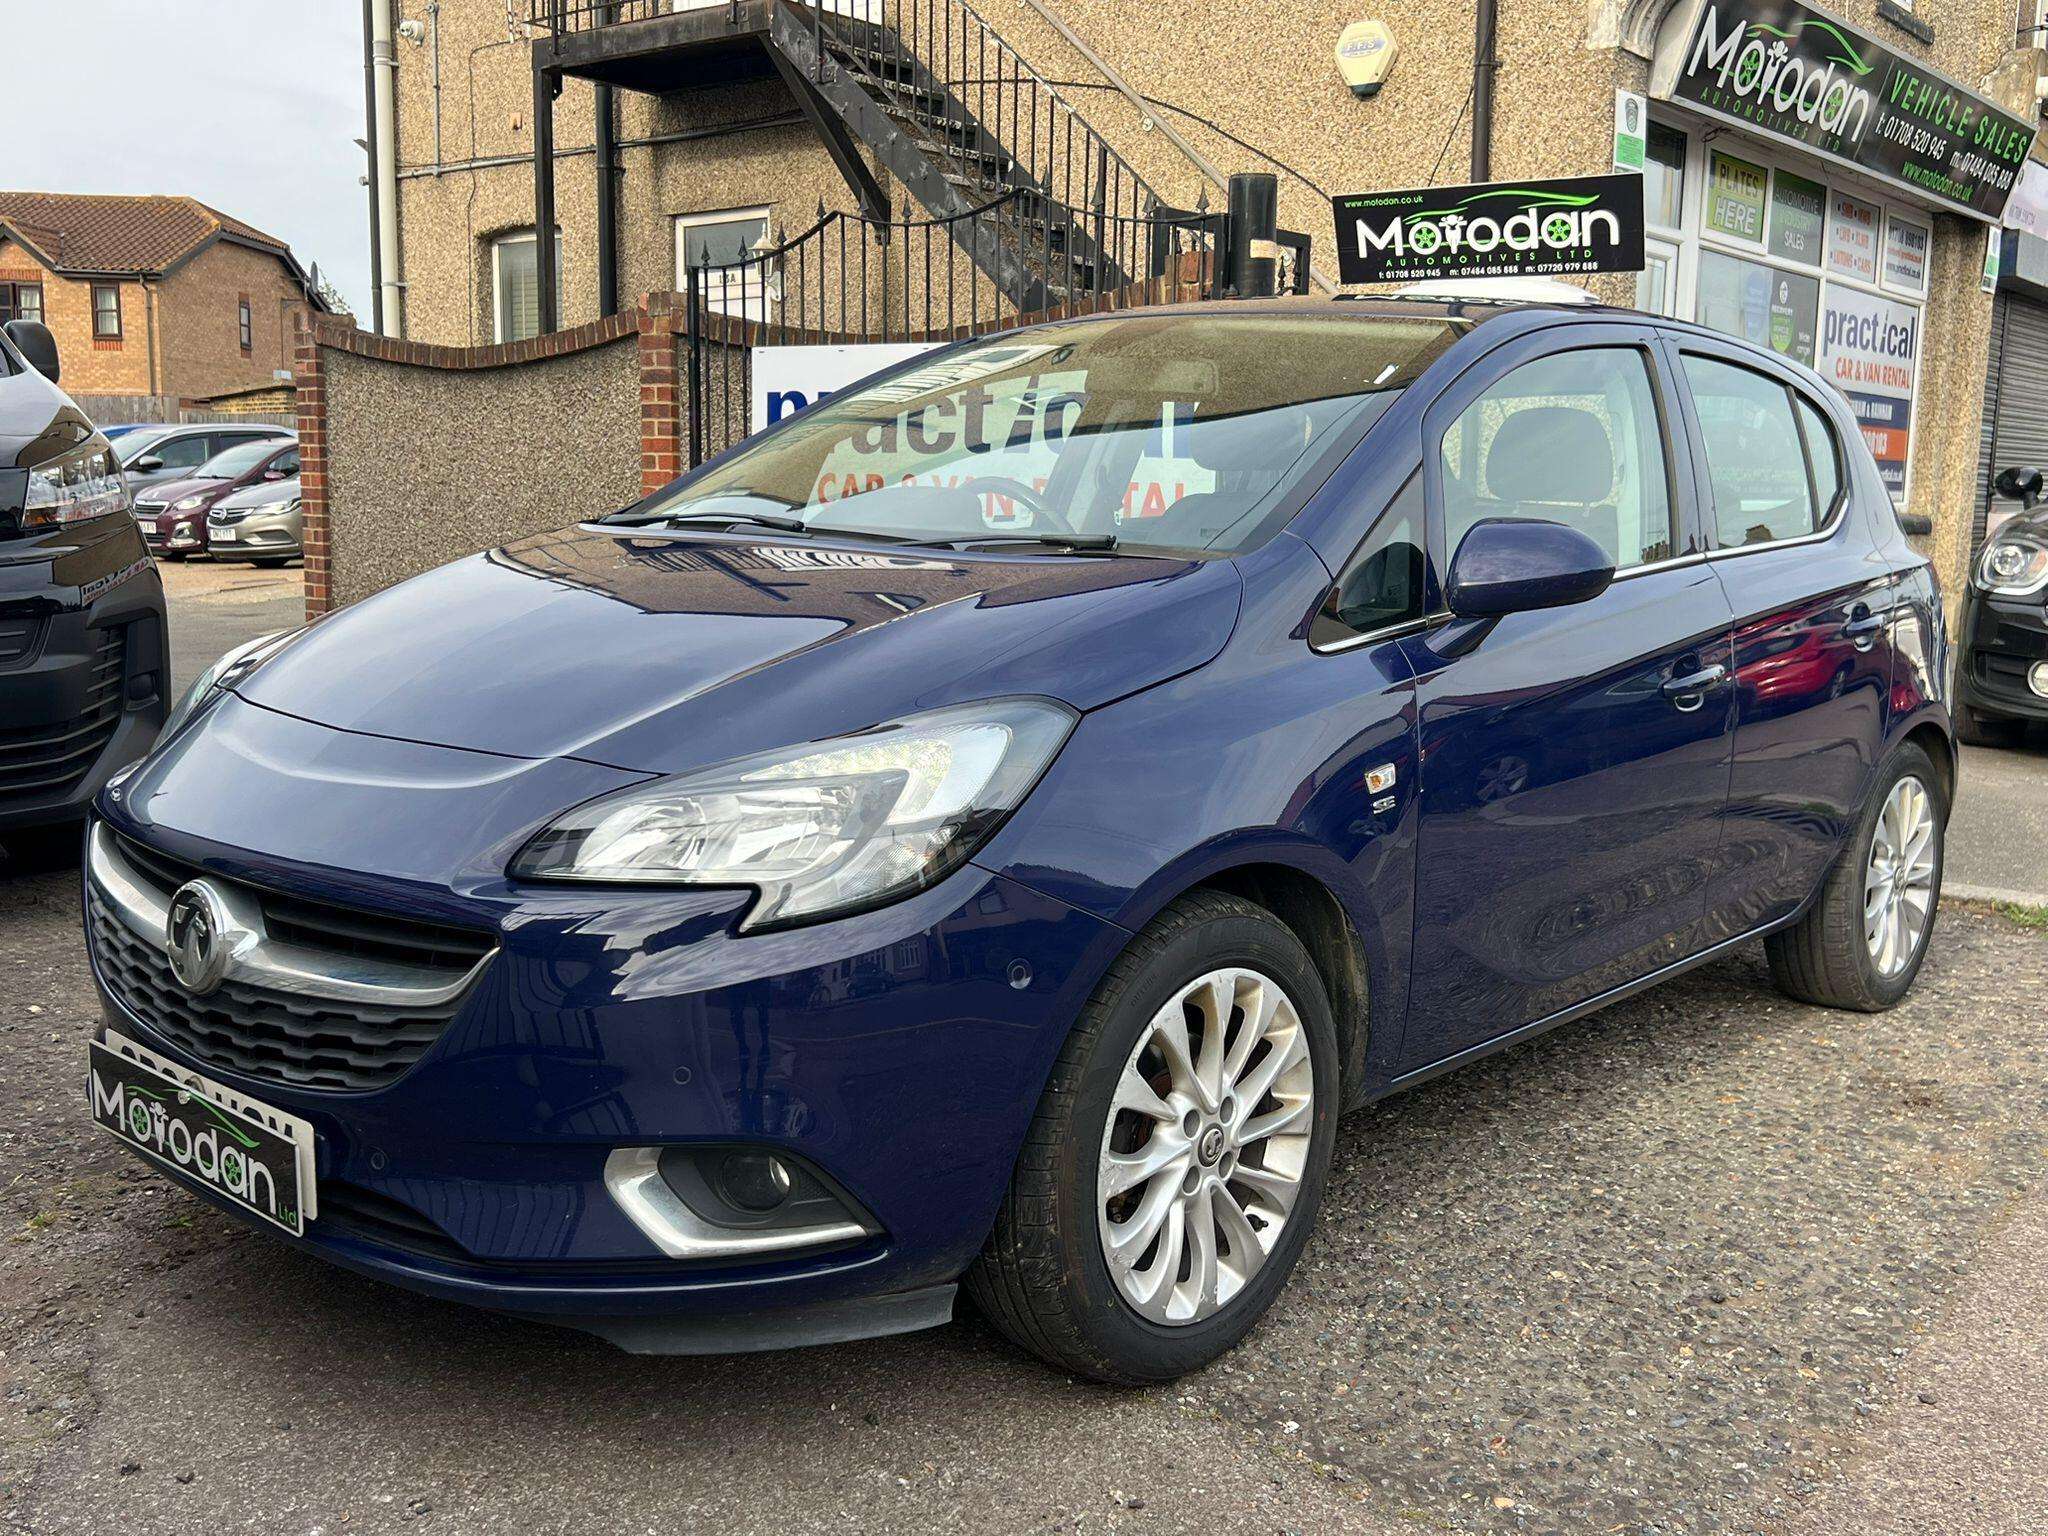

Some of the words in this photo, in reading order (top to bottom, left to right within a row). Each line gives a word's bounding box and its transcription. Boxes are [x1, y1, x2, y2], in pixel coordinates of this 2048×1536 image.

[1687, 5, 1870, 142] Motodan
[1701, 87, 1809, 141] AUTOMOTIVES
[1817, 136, 1840, 152] LTD
[1890, 70, 1974, 137] VEHICLE
[1974, 115, 2028, 163] SALES
[1884, 116, 1913, 146] 01708
[1911, 128, 1931, 153] 520
[1927, 136, 1947, 160] 945
[1720, 163, 1759, 198] PLATES
[1902, 161, 1974, 202] www.motodan.co.uk
[1344, 195, 1424, 208] www.motodan.co.uk
[1713, 196, 1756, 235] HERE
[1355, 207, 1620, 259] Motodan
[1784, 231, 1804, 251] SALES
[1385, 252, 1536, 268] AUTOMOTIVES
[1556, 249, 1592, 260] LTD
[1385, 269, 1409, 279] 01708
[1410, 269, 1425, 278] 520
[1426, 268, 1441, 277] 945
[1449, 268, 1460, 276] m:
[1486, 265, 1502, 275] 085
[1525, 264, 1536, 273] m:
[1537, 263, 1563, 273] 07720
[1564, 262, 1580, 271] 979
[1582, 261, 1598, 270] 888
[1823, 308, 1915, 360] practical
[1836, 357, 1853, 380] CAR
[1855, 360, 1861, 382] &
[1864, 361, 1881, 385] VAN
[1882, 366, 1910, 390] RENTAL
[93, 1068, 277, 1216] Motodan
[278, 1202, 298, 1226] Ltd
